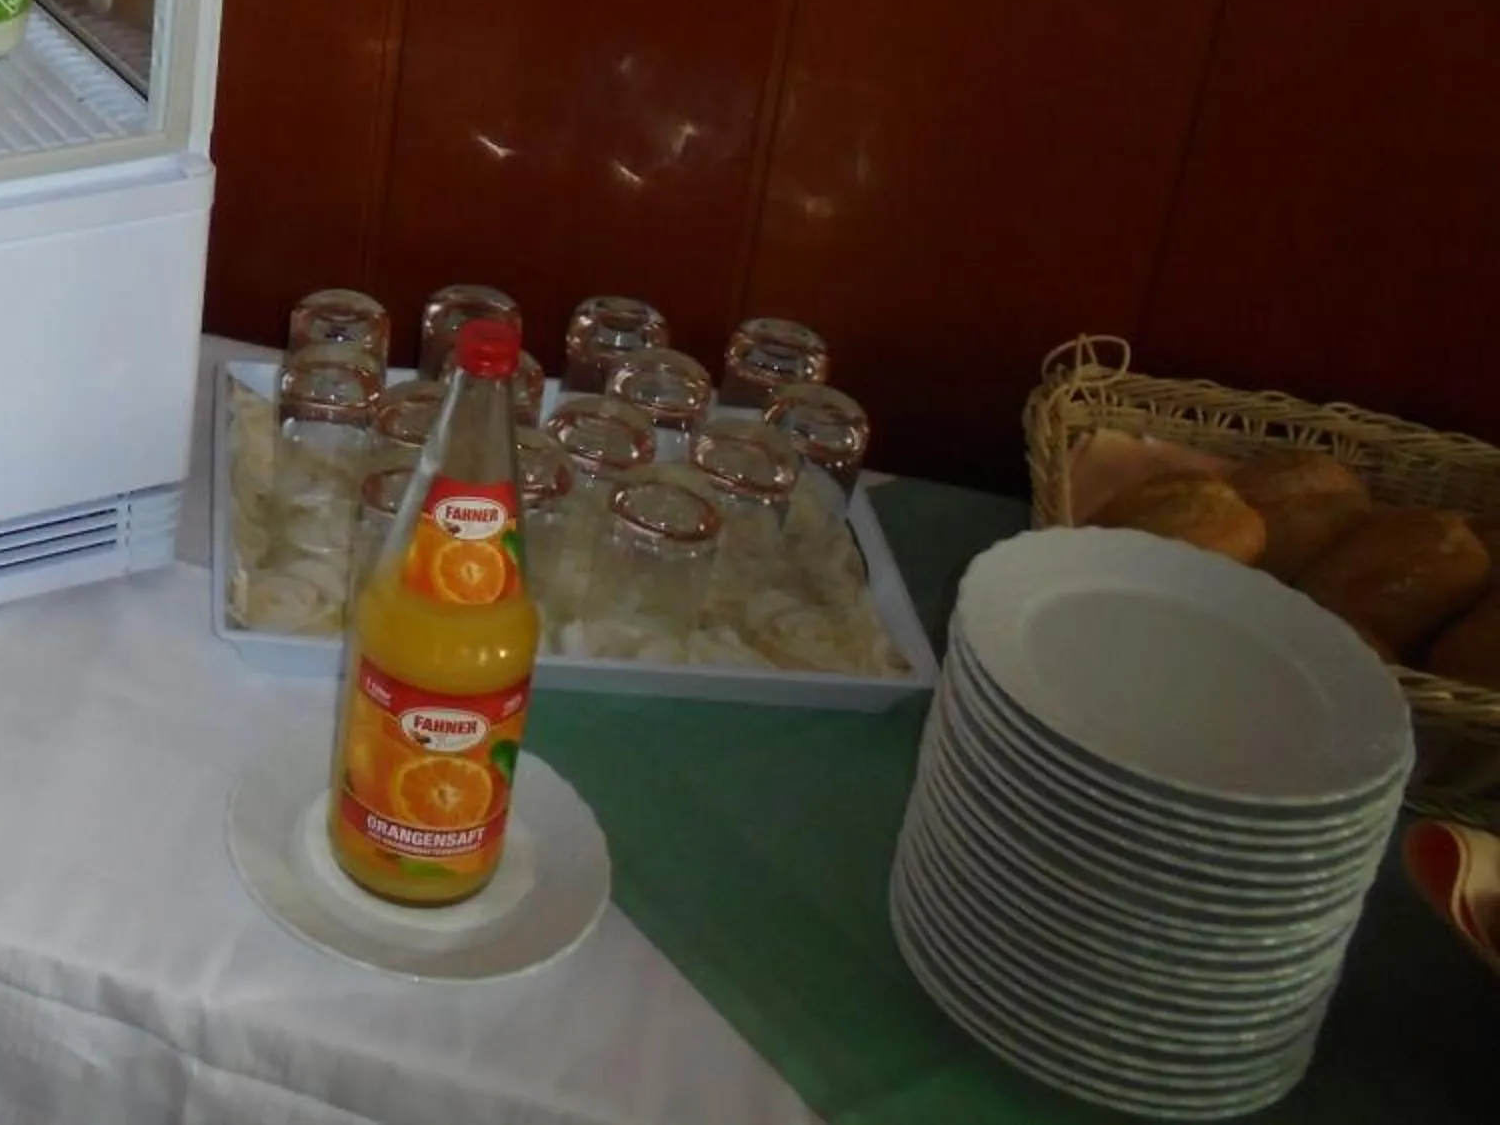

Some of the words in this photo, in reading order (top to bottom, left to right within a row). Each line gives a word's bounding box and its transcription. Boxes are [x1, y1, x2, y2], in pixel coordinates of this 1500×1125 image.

[446, 504, 499, 523] FAHNER
[413, 714, 478, 735] FAHNER
[366, 813, 486, 848] ORANGENSAFT
